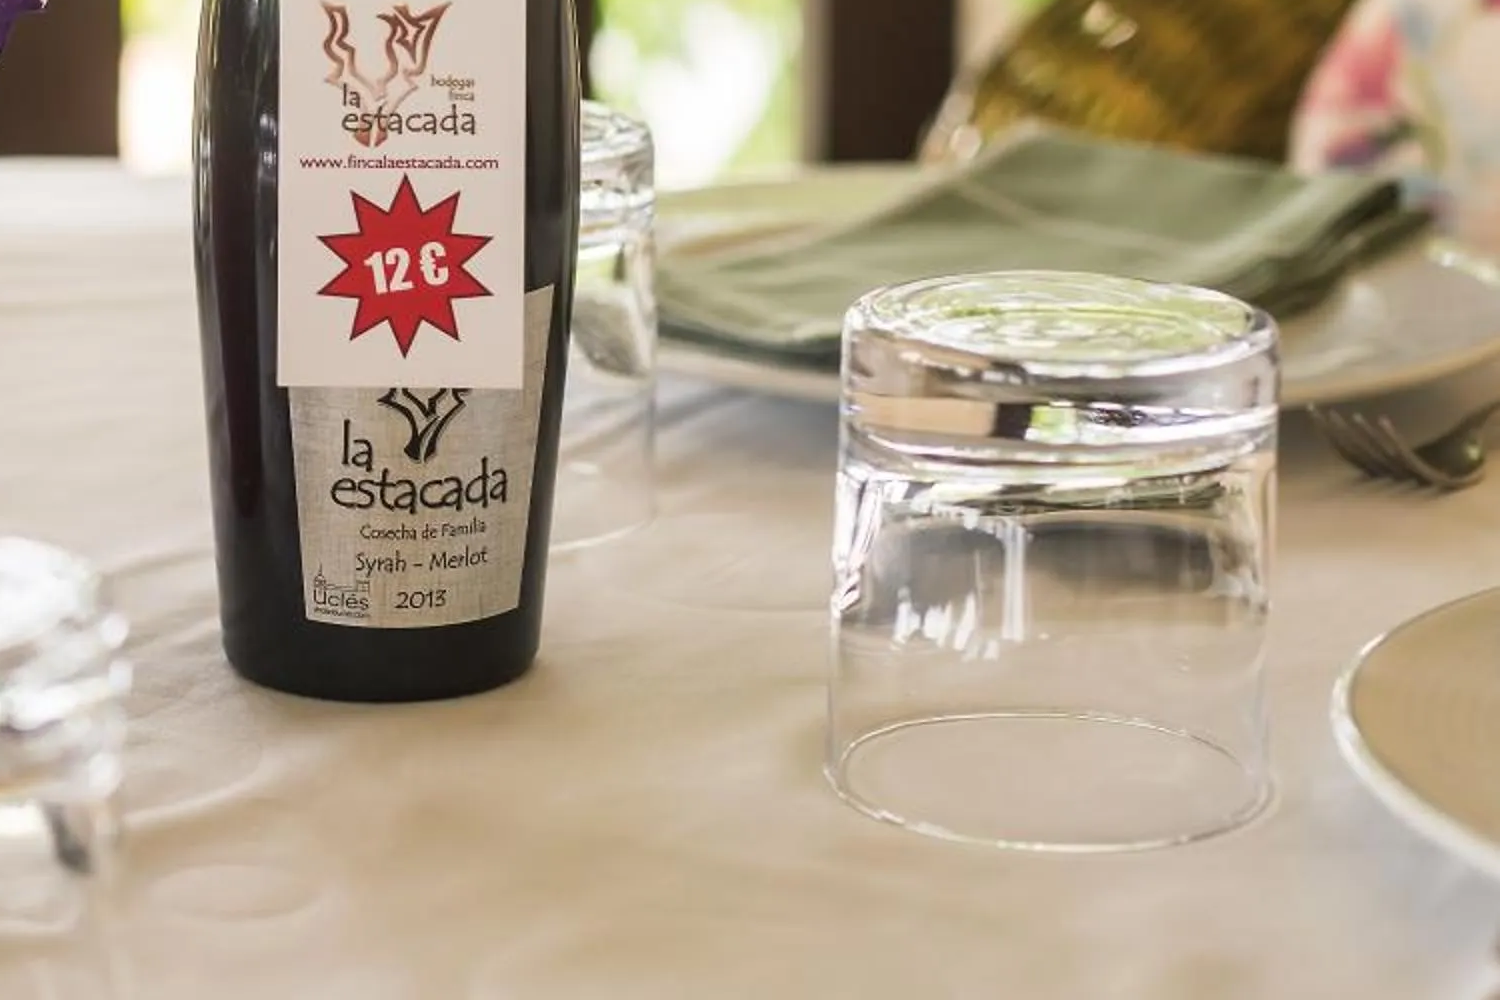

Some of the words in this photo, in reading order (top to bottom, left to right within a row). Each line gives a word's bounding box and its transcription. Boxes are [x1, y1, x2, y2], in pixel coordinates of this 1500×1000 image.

[342, 83, 361, 108] la
[341, 103, 476, 135] estacada
[300, 155, 499, 170] www.fincalaestacada.com
[342, 418, 373, 472] la
[330, 456, 508, 514] estacada
[359, 523, 417, 540] Cosecha
[421, 523, 437, 540] de
[441, 516, 486, 538] Familia
[355, 550, 407, 577] Syrah
[429, 546, 488, 571] Merlot
[313, 588, 369, 610] Uclés
[395, 588, 447, 609] 2013
